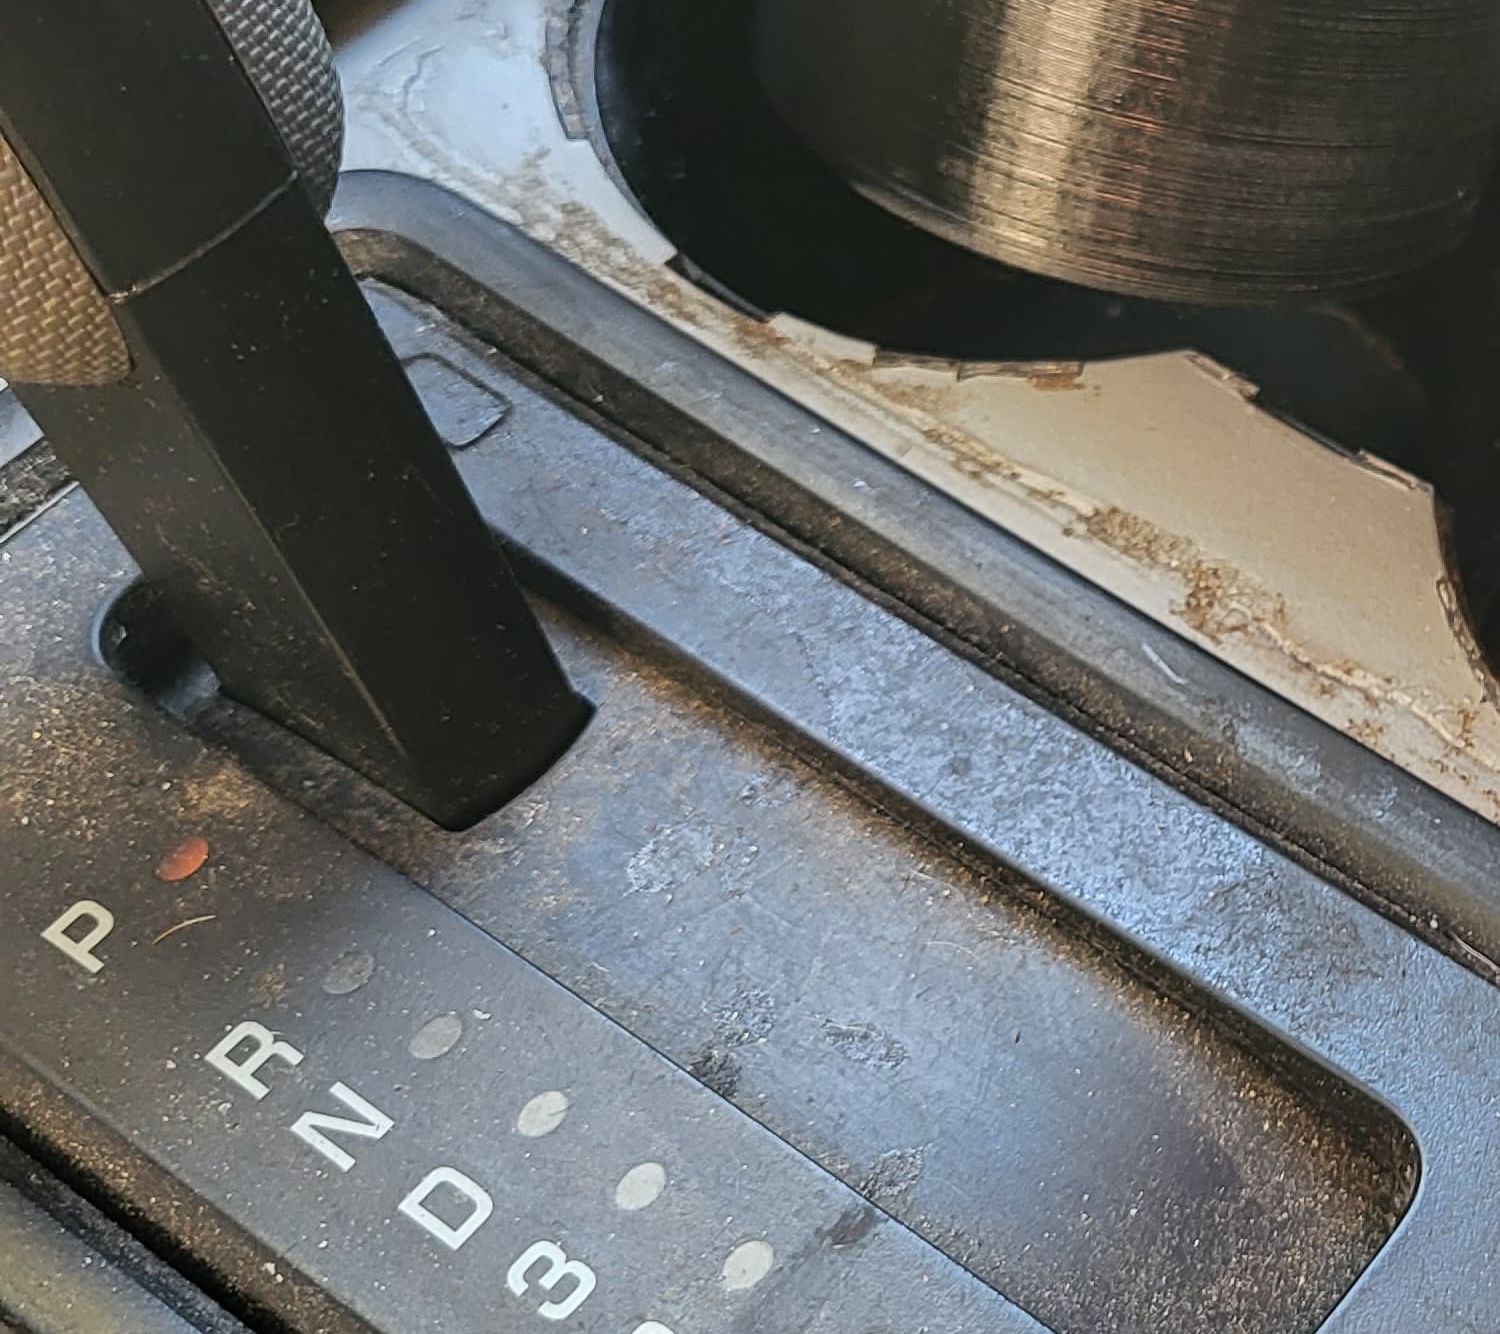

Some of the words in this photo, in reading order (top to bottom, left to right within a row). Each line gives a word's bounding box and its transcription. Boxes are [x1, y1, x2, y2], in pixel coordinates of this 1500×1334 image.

[40, 899, 116, 974] P
[204, 1020, 305, 1101] R
[290, 1081, 394, 1172] N
[399, 1166, 494, 1251] D
[506, 1240, 598, 1321] 3
